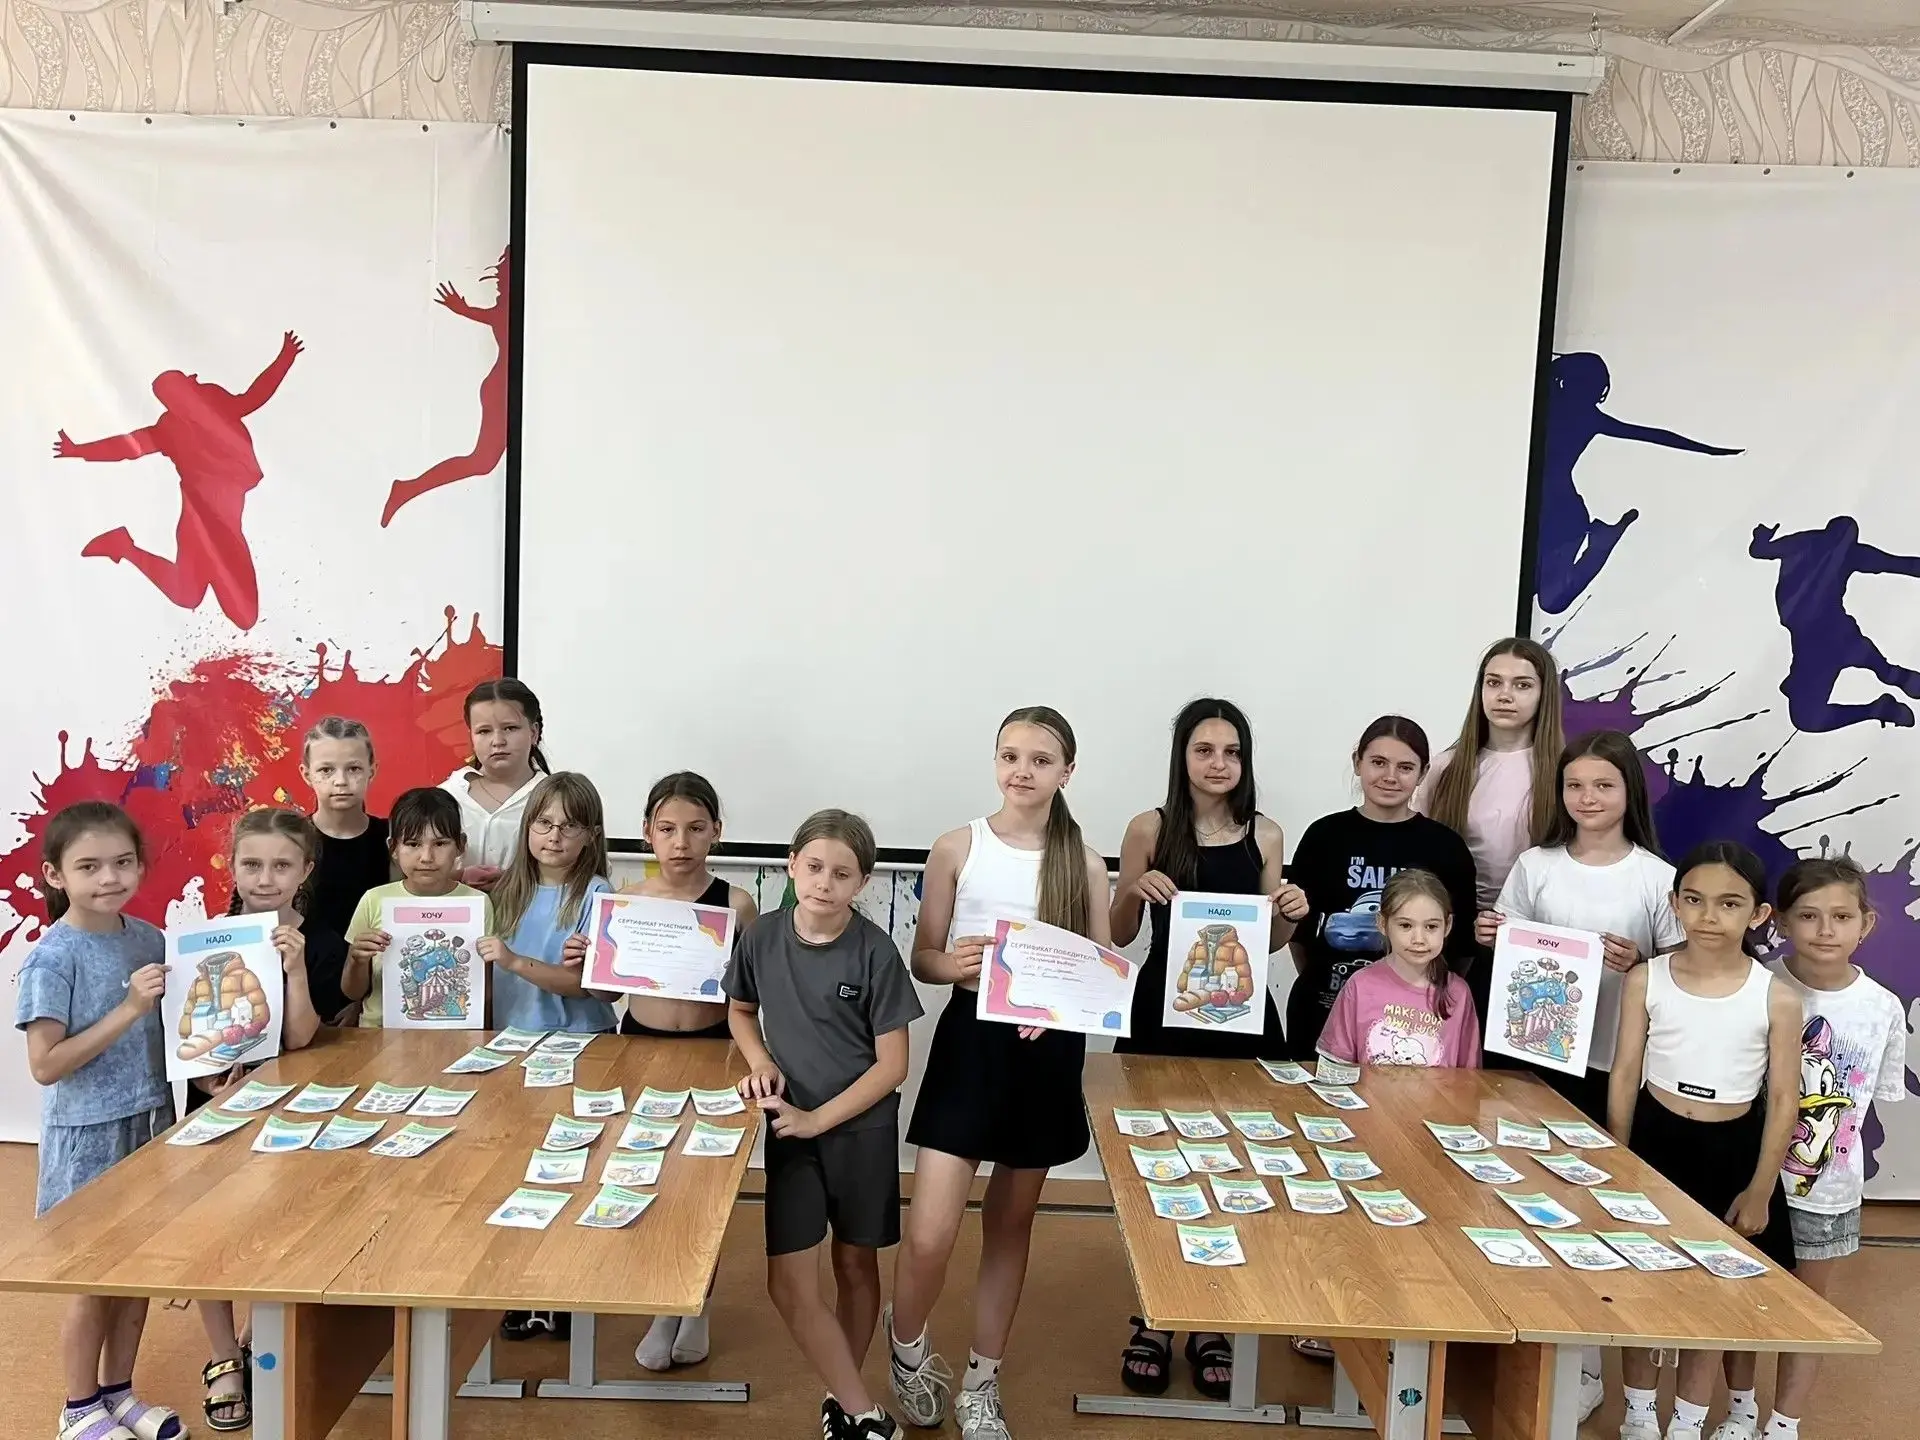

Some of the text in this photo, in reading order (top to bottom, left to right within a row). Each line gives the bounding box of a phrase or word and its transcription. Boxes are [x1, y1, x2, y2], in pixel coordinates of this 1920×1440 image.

[1350, 857, 1365, 866] I'M
[1347, 865, 1406, 888] SAL
[420, 911, 443, 920] ХОЧУ
[1208, 907, 1232, 917] НАДО
[618, 918, 657, 927] СЕРТИФИКАТ
[658, 922, 693, 931] УЧАСТНИКА
[205, 933, 232, 945] НАДО
[1536, 937, 1560, 949] ХОЧУ
[1010, 942, 1053, 952] СЕРТИФИКАТ
[1053, 948, 1097, 961] ПОБЕДИТЕЛЯ
[1383, 1004, 1416, 1020] MAKE
[1384, 1015, 1412, 1030] OWN
[1414, 1023, 1439, 1037] LUCK
